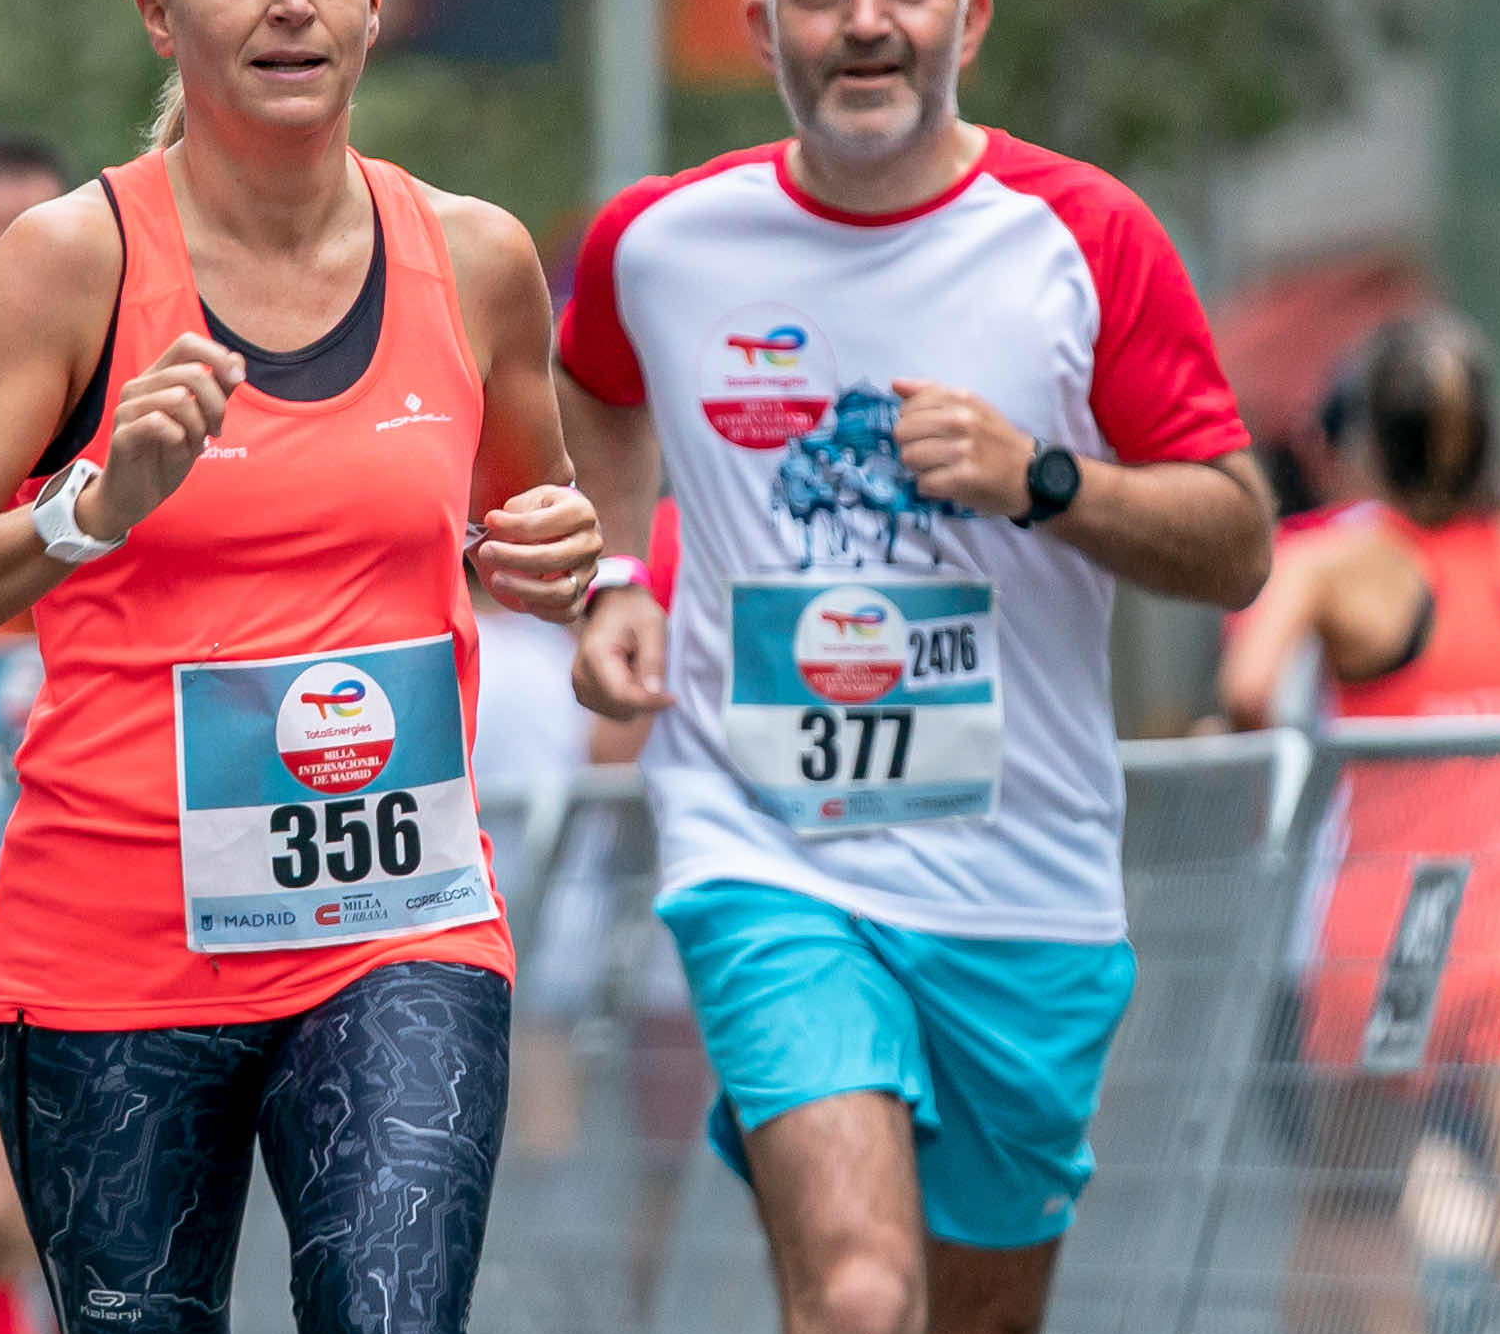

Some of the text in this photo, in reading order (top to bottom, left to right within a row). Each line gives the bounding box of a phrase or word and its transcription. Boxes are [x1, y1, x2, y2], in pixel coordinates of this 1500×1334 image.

[909, 622, 979, 678] 2476
[304, 723, 373, 740] TotalEnergies
[800, 706, 916, 782] 377
[324, 748, 357, 761] MILLA
[312, 769, 372, 786] DE MADRID
[270, 790, 423, 889] 356
[343, 898, 381, 911] MILLA
[224, 911, 297, 928] MADRID
